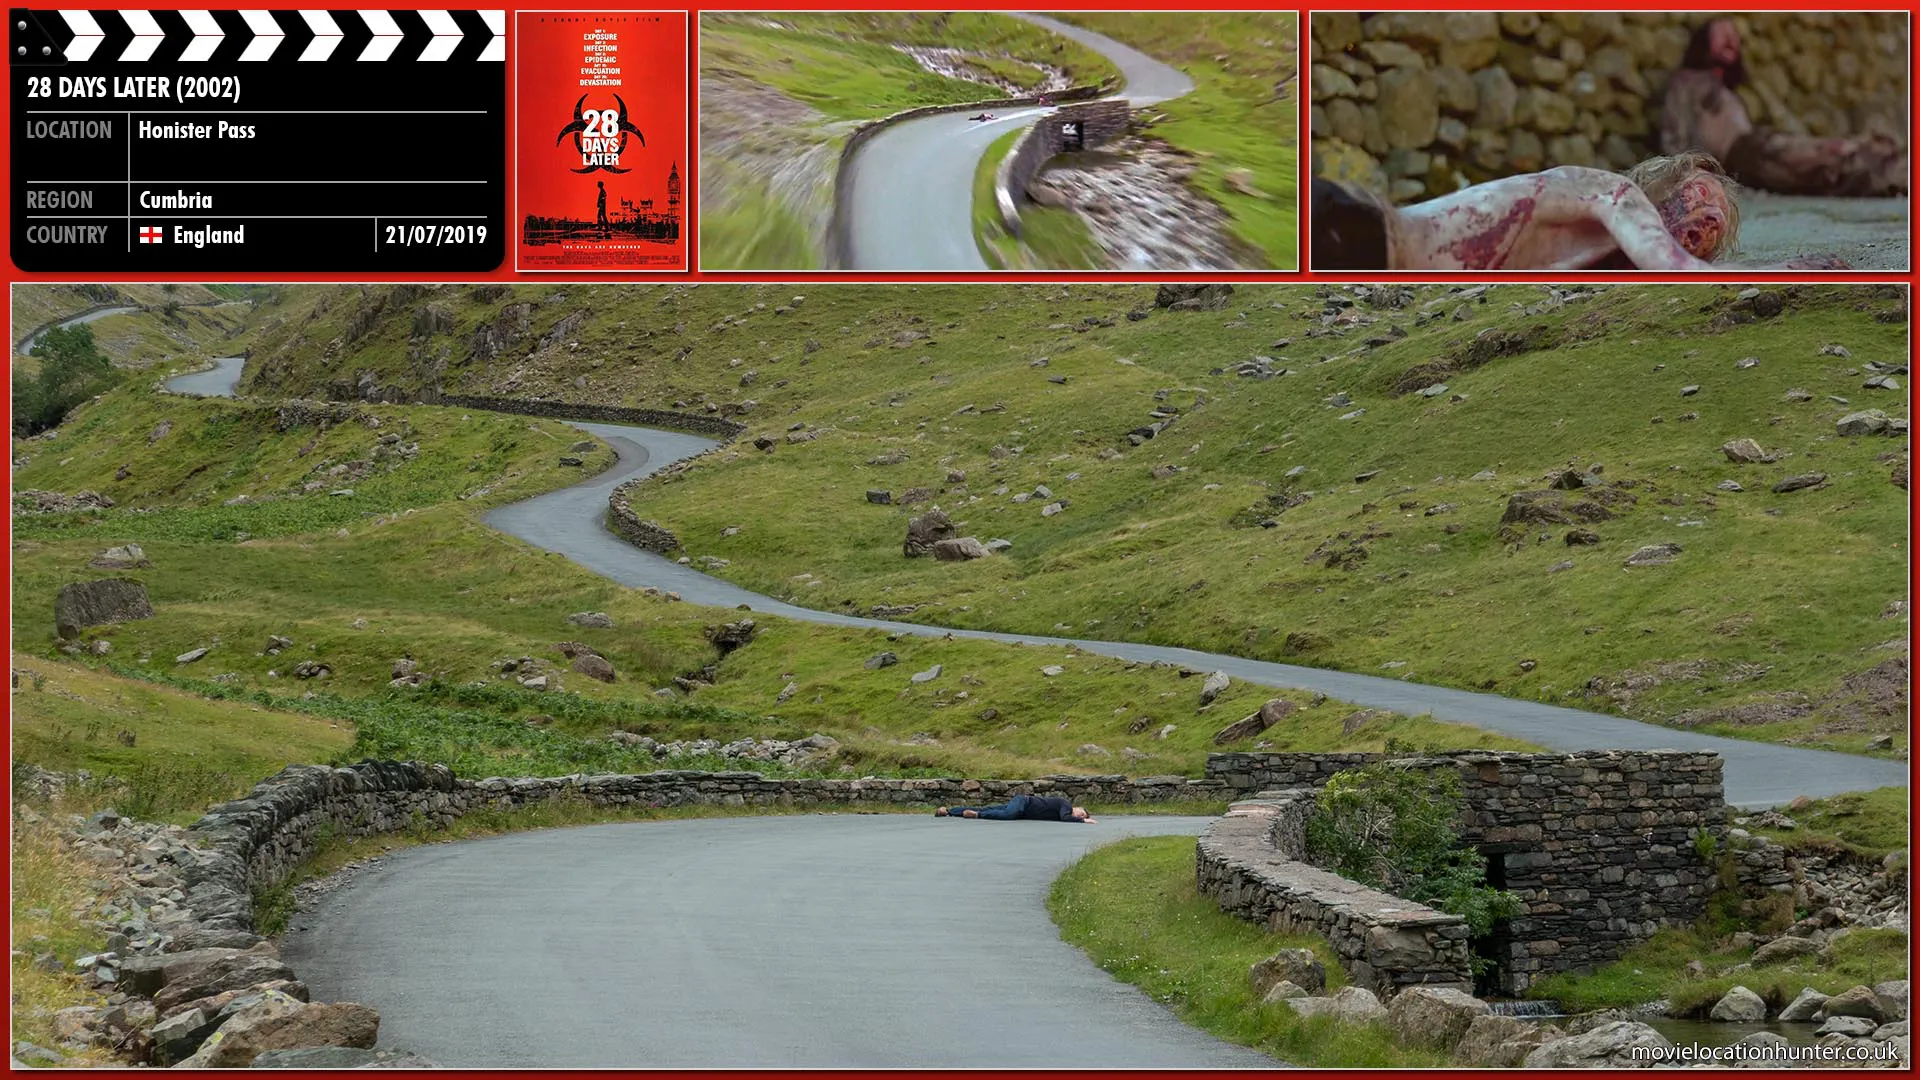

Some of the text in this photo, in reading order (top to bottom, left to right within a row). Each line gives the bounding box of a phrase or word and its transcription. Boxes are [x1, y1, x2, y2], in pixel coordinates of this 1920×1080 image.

[583, 33, 617, 41] EXPOSURE
[583, 44, 618, 52] INFECTION
[584, 56, 617, 64] EPIDEMIC
[580, 67, 621, 75] EVACUATION
[579, 79, 622, 87] DEVASTATION
[582, 109, 619, 138] 28
[582, 138, 619, 153] DAYS
[582, 153, 619, 166] LATER
